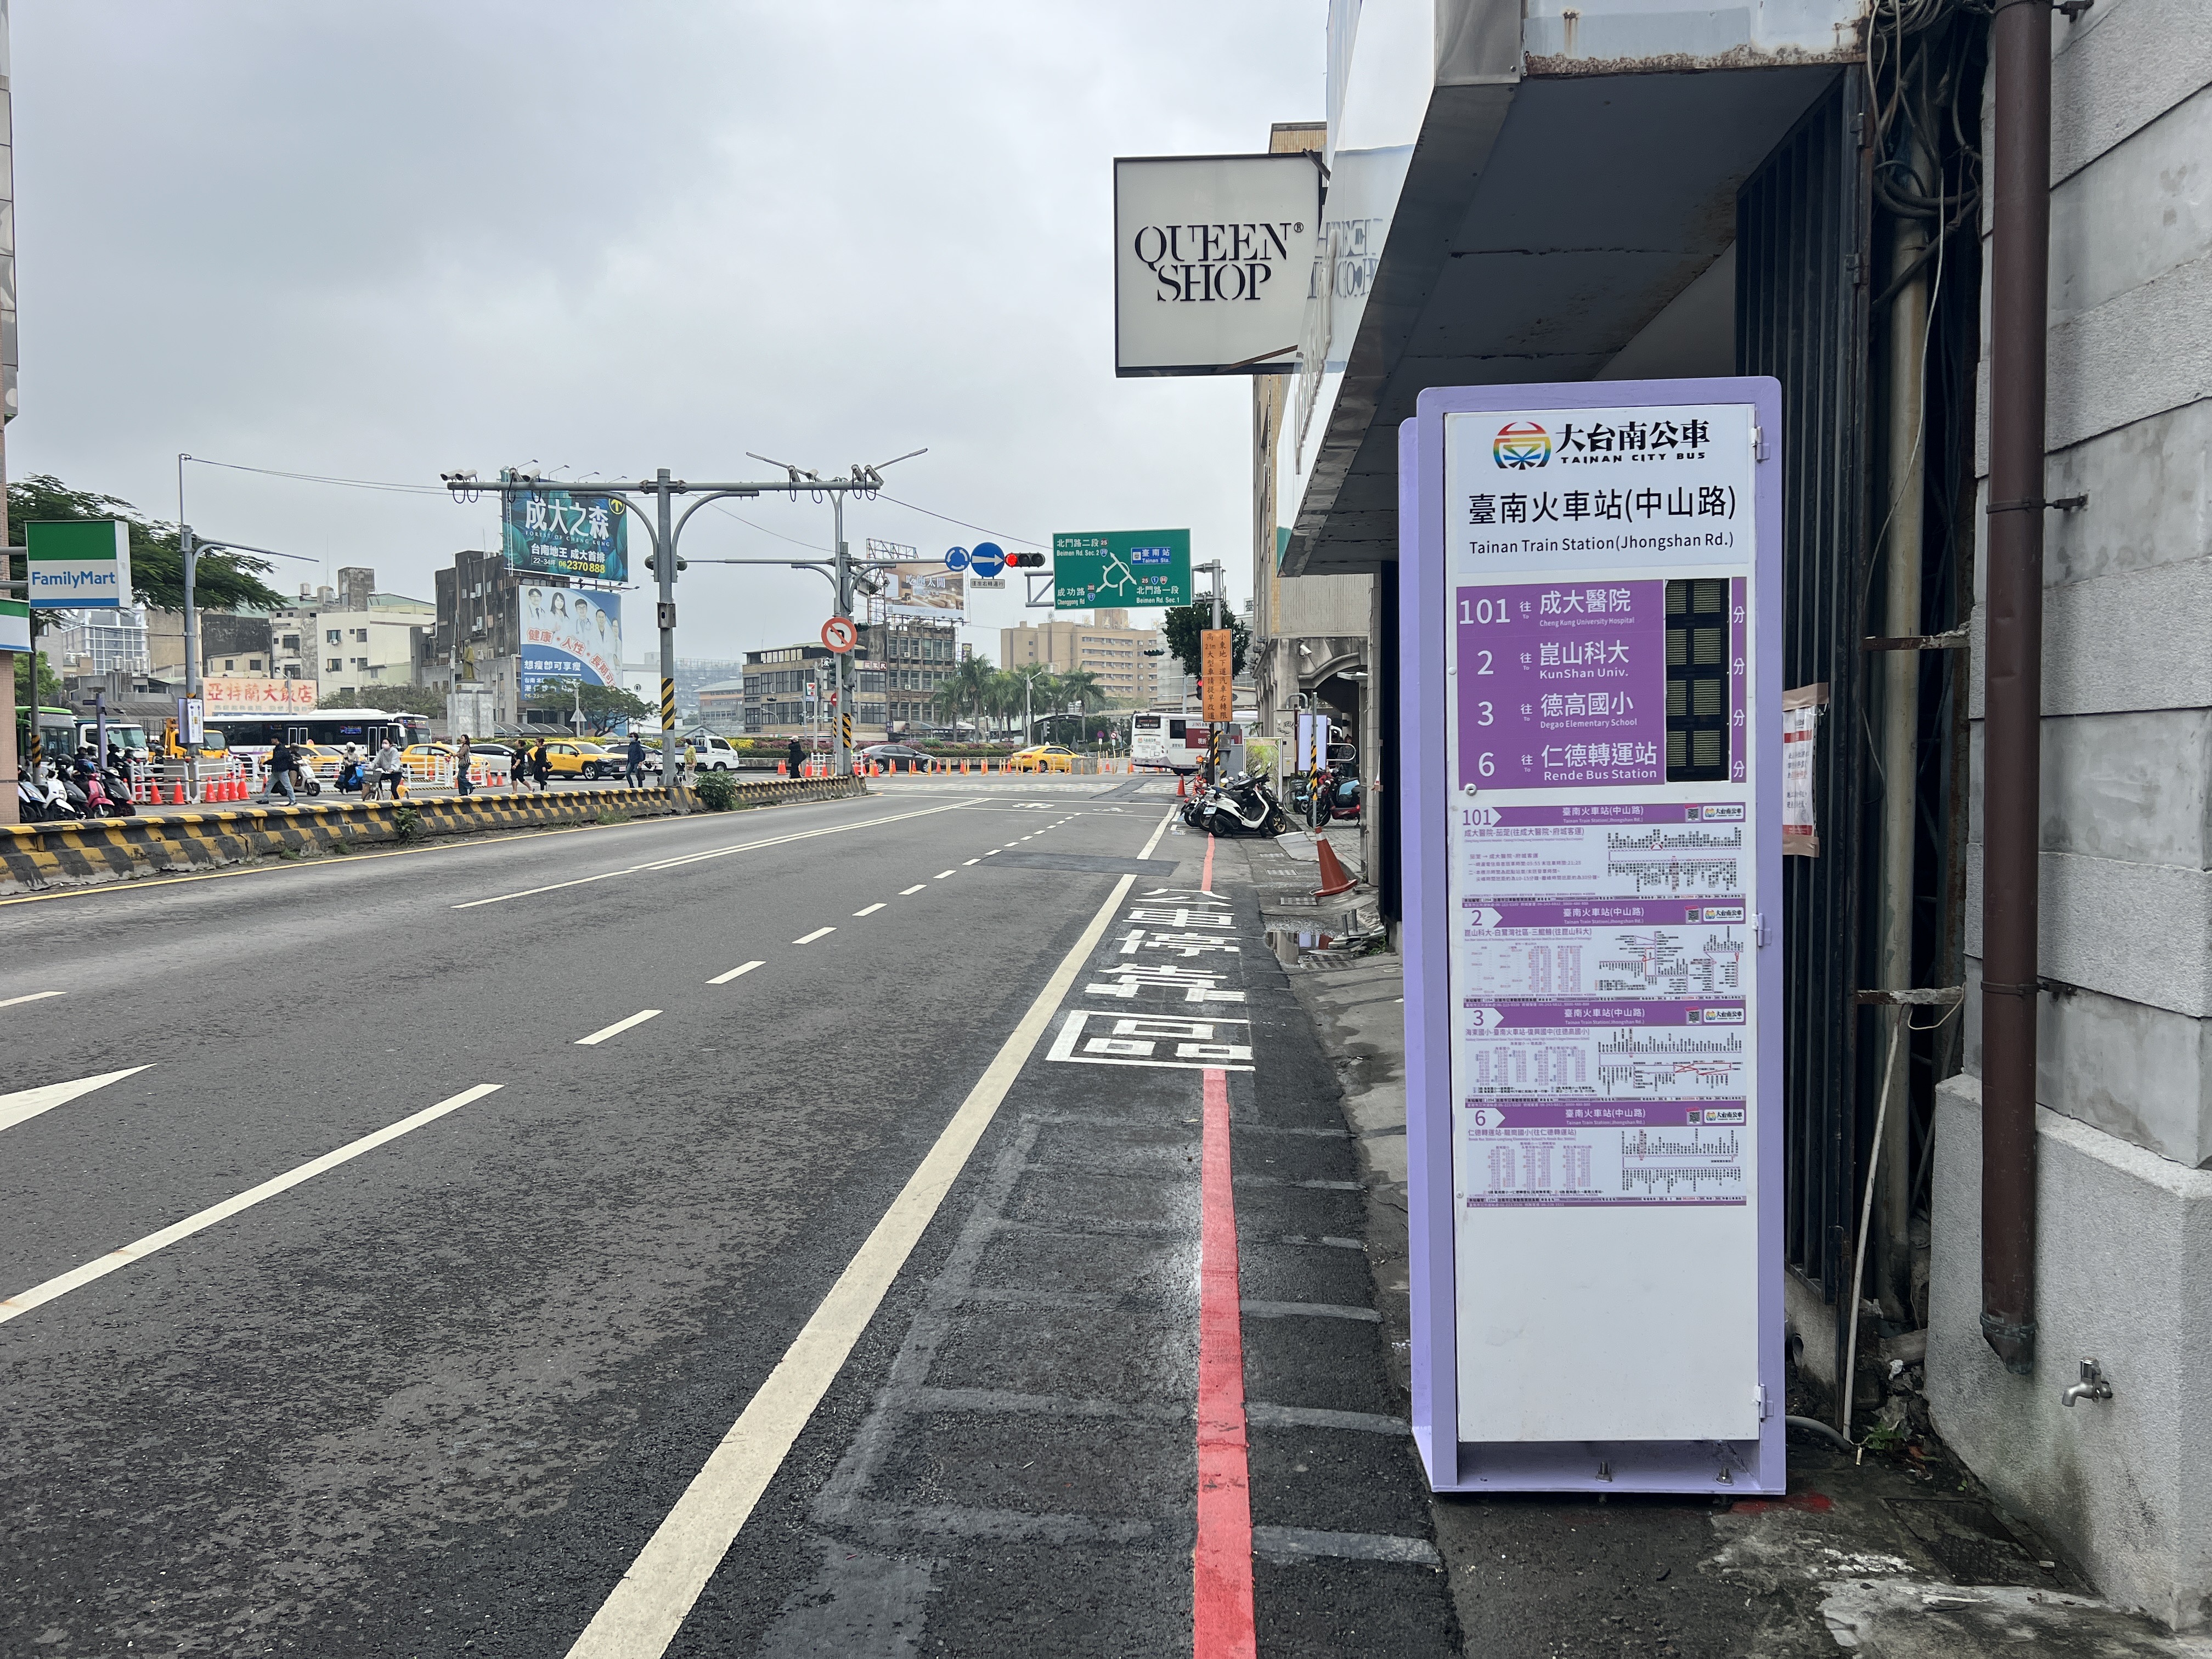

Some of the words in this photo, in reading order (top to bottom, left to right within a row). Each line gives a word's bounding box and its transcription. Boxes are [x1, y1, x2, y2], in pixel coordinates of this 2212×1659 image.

[1156, 263, 1272, 302] SHOP
[1555, 419, 1711, 453] 大台南公車
[1561, 455, 1622, 464] TAINAN
[1632, 453, 1667, 462] CITY
[1469, 485, 1736, 525] 臺南火車站(中山路)
[525, 498, 609, 540] 成大之森
[525, 531, 551, 539] FOREST
[1057, 538, 1099, 548] 北門路二段
[1470, 541, 1518, 554] Tainan
[1522, 538, 1559, 552] Train
[1562, 534, 1701, 552] Station(Jhongshan
[1705, 531, 1734, 548] Rd.)
[531, 543, 568, 558] 台南地王
[570, 549, 606, 563] 成大首排
[1142, 549, 1170, 557] 臺南站
[32, 571, 116, 588] FamilyMart
[1057, 588, 1085, 596] 成功路
[1136, 585, 1179, 595] 北門路一段
[1459, 599, 1510, 624] 101
[1519, 601, 1532, 612] 往
[1539, 588, 1631, 615] 成大醫院
[1733, 606, 1745, 623] 分
[1539, 619, 1559, 628] Cheng
[1576, 618, 1608, 626] University
[1609, 617, 1635, 625] Hospital
[1477, 650, 1494, 675] 2
[1520, 652, 1532, 664] 往
[1539, 639, 1629, 666] 崑山科大
[1733, 658, 1745, 675] 分
[1219, 633, 1227, 719] 小東地下道汽車右轉限
[1539, 668, 1595, 680] KunShan
[1597, 667, 1629, 678] Univ.
[207, 682, 313, 703] 亞特蘭大飯店
[1477, 701, 1494, 726] 3
[1520, 703, 1533, 715] 往
[1540, 691, 1634, 718] 德高國小
[1733, 709, 1745, 726] 分
[1540, 721, 1564, 730] Degao
[1566, 719, 1610, 729] Elementary
[1611, 718, 1638, 726] School
[1478, 752, 1495, 777] 6
[1521, 754, 1533, 766] 往
[1541, 741, 1657, 769] 仁德轉運站
[1733, 760, 1745, 777] 分
[1544, 770, 1583, 781] Rende
[1585, 770, 1609, 780] Bus
[1611, 768, 1657, 779] Station
[1463, 809, 1491, 825] 101
[1562, 806, 1644, 816] 臺南火車站(中山路)
[1471, 910, 1482, 926] 2
[1564, 907, 1644, 917] 臺南火車站(中山路)
[1473, 1010, 1484, 1026] 3
[1564, 1008, 1645, 1018] 臺南火車站(中山路)
[1475, 1110, 1486, 1126] 6
[1565, 1108, 1646, 1119] 臺南火車站(中山路)
